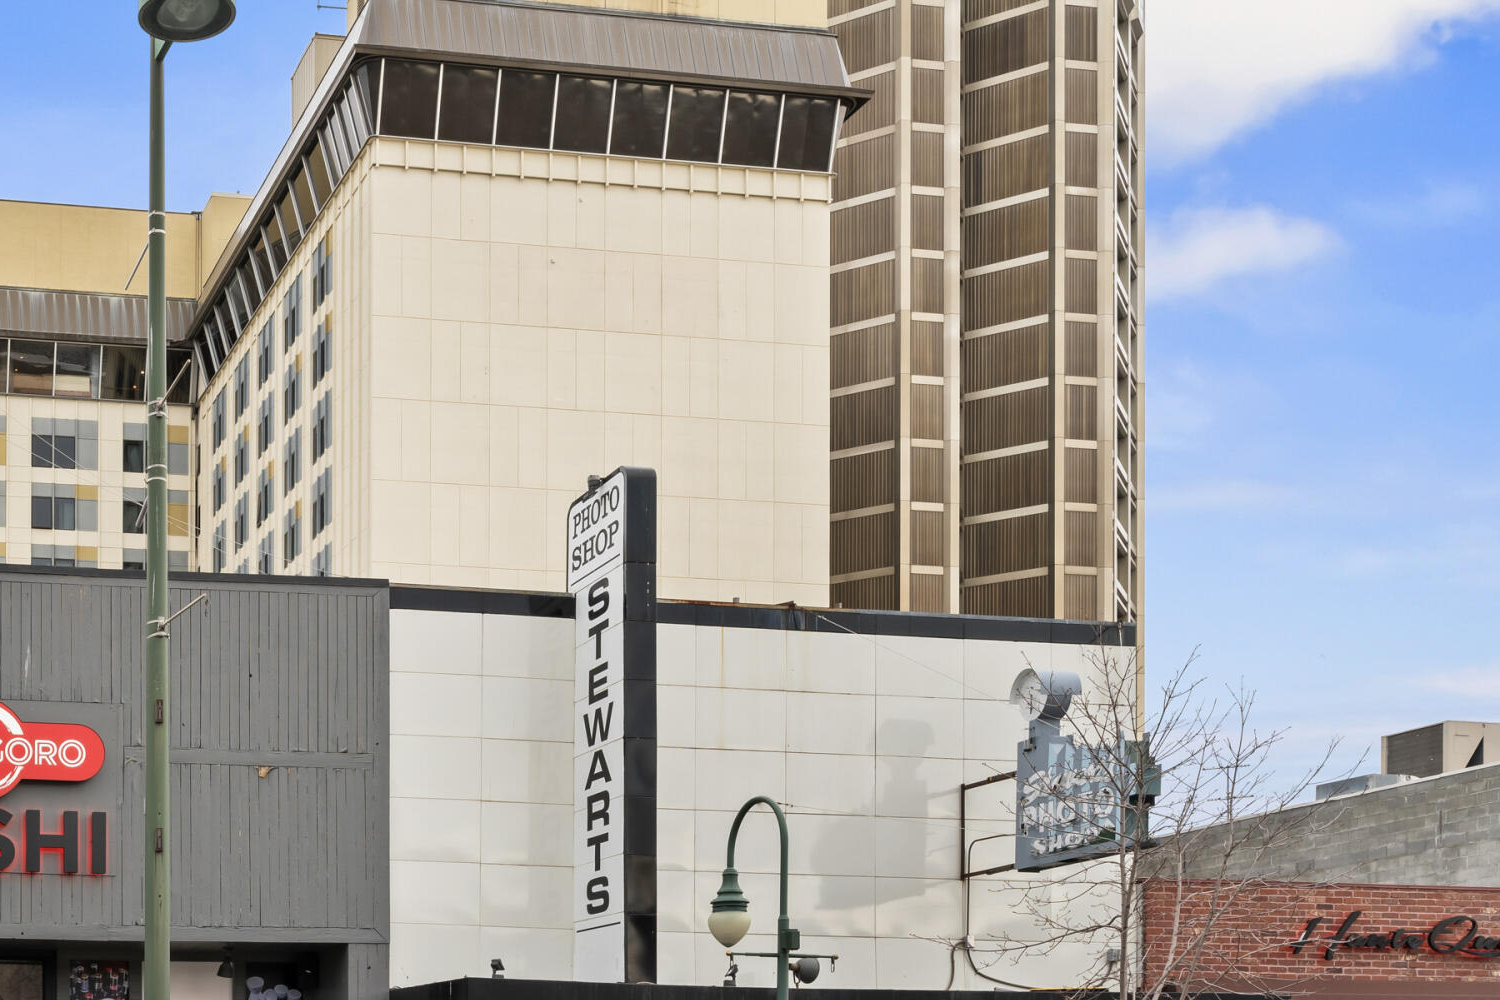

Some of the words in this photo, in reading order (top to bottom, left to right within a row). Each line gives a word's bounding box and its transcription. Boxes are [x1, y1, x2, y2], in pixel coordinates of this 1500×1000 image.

[572, 485, 620, 539] PHOTO
[571, 520, 619, 573] SHOP
[583, 577, 614, 915] STEWARTS
